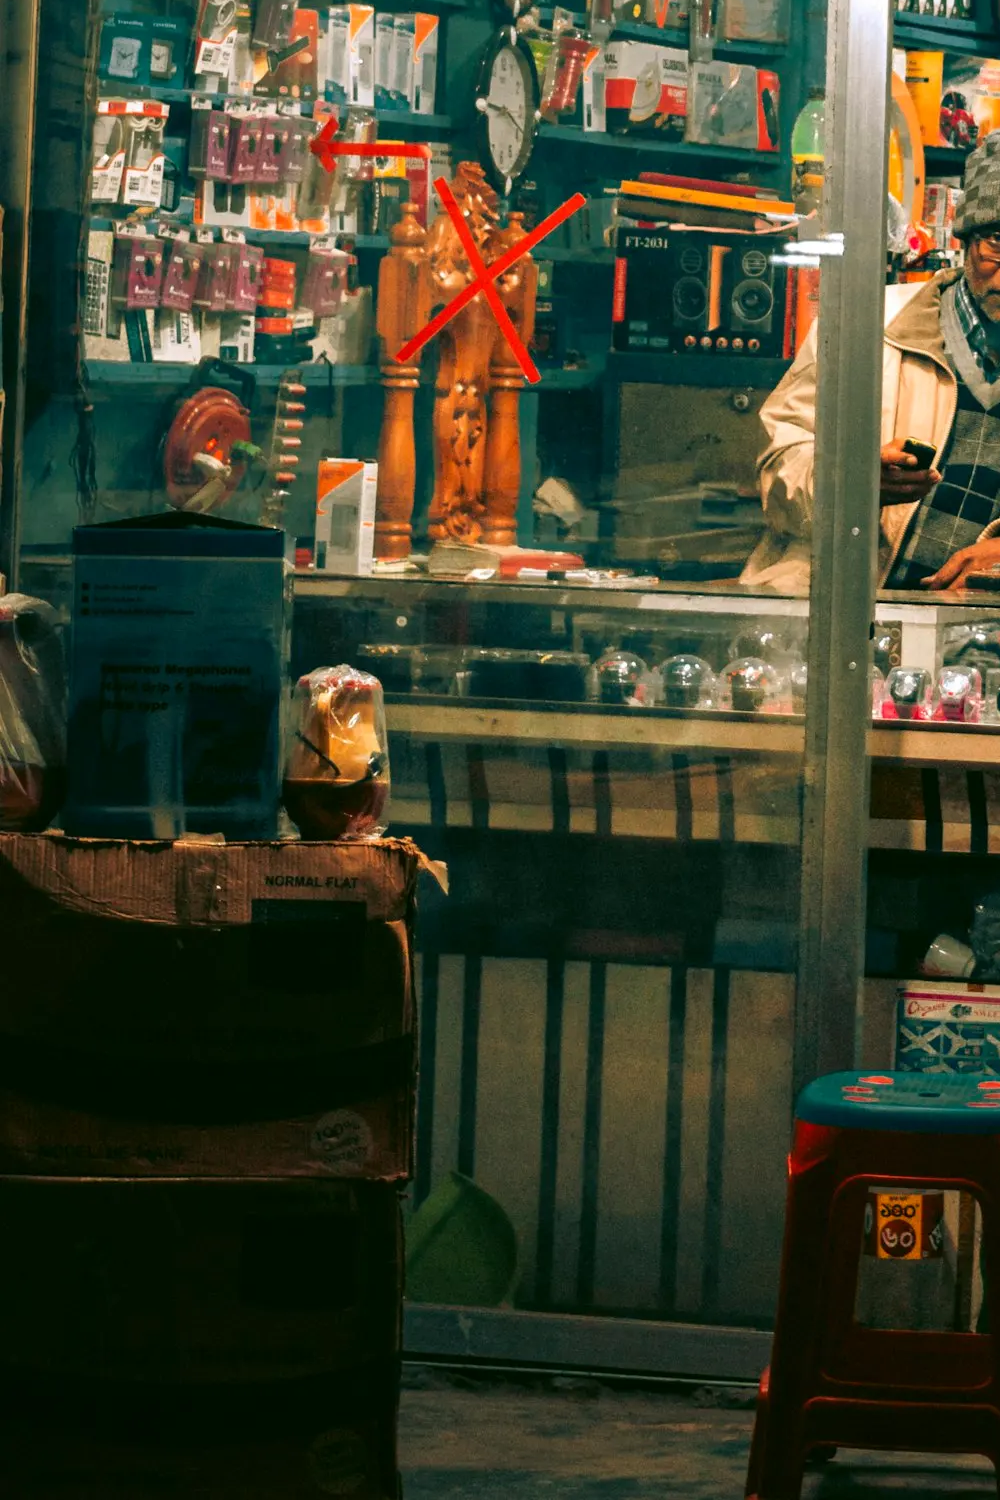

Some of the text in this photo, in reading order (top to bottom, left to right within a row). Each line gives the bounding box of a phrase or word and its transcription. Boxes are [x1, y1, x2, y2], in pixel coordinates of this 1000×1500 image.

[625, 235, 668, 249] FT-2031
[265, 875, 359, 890] NORMAL FLAT
